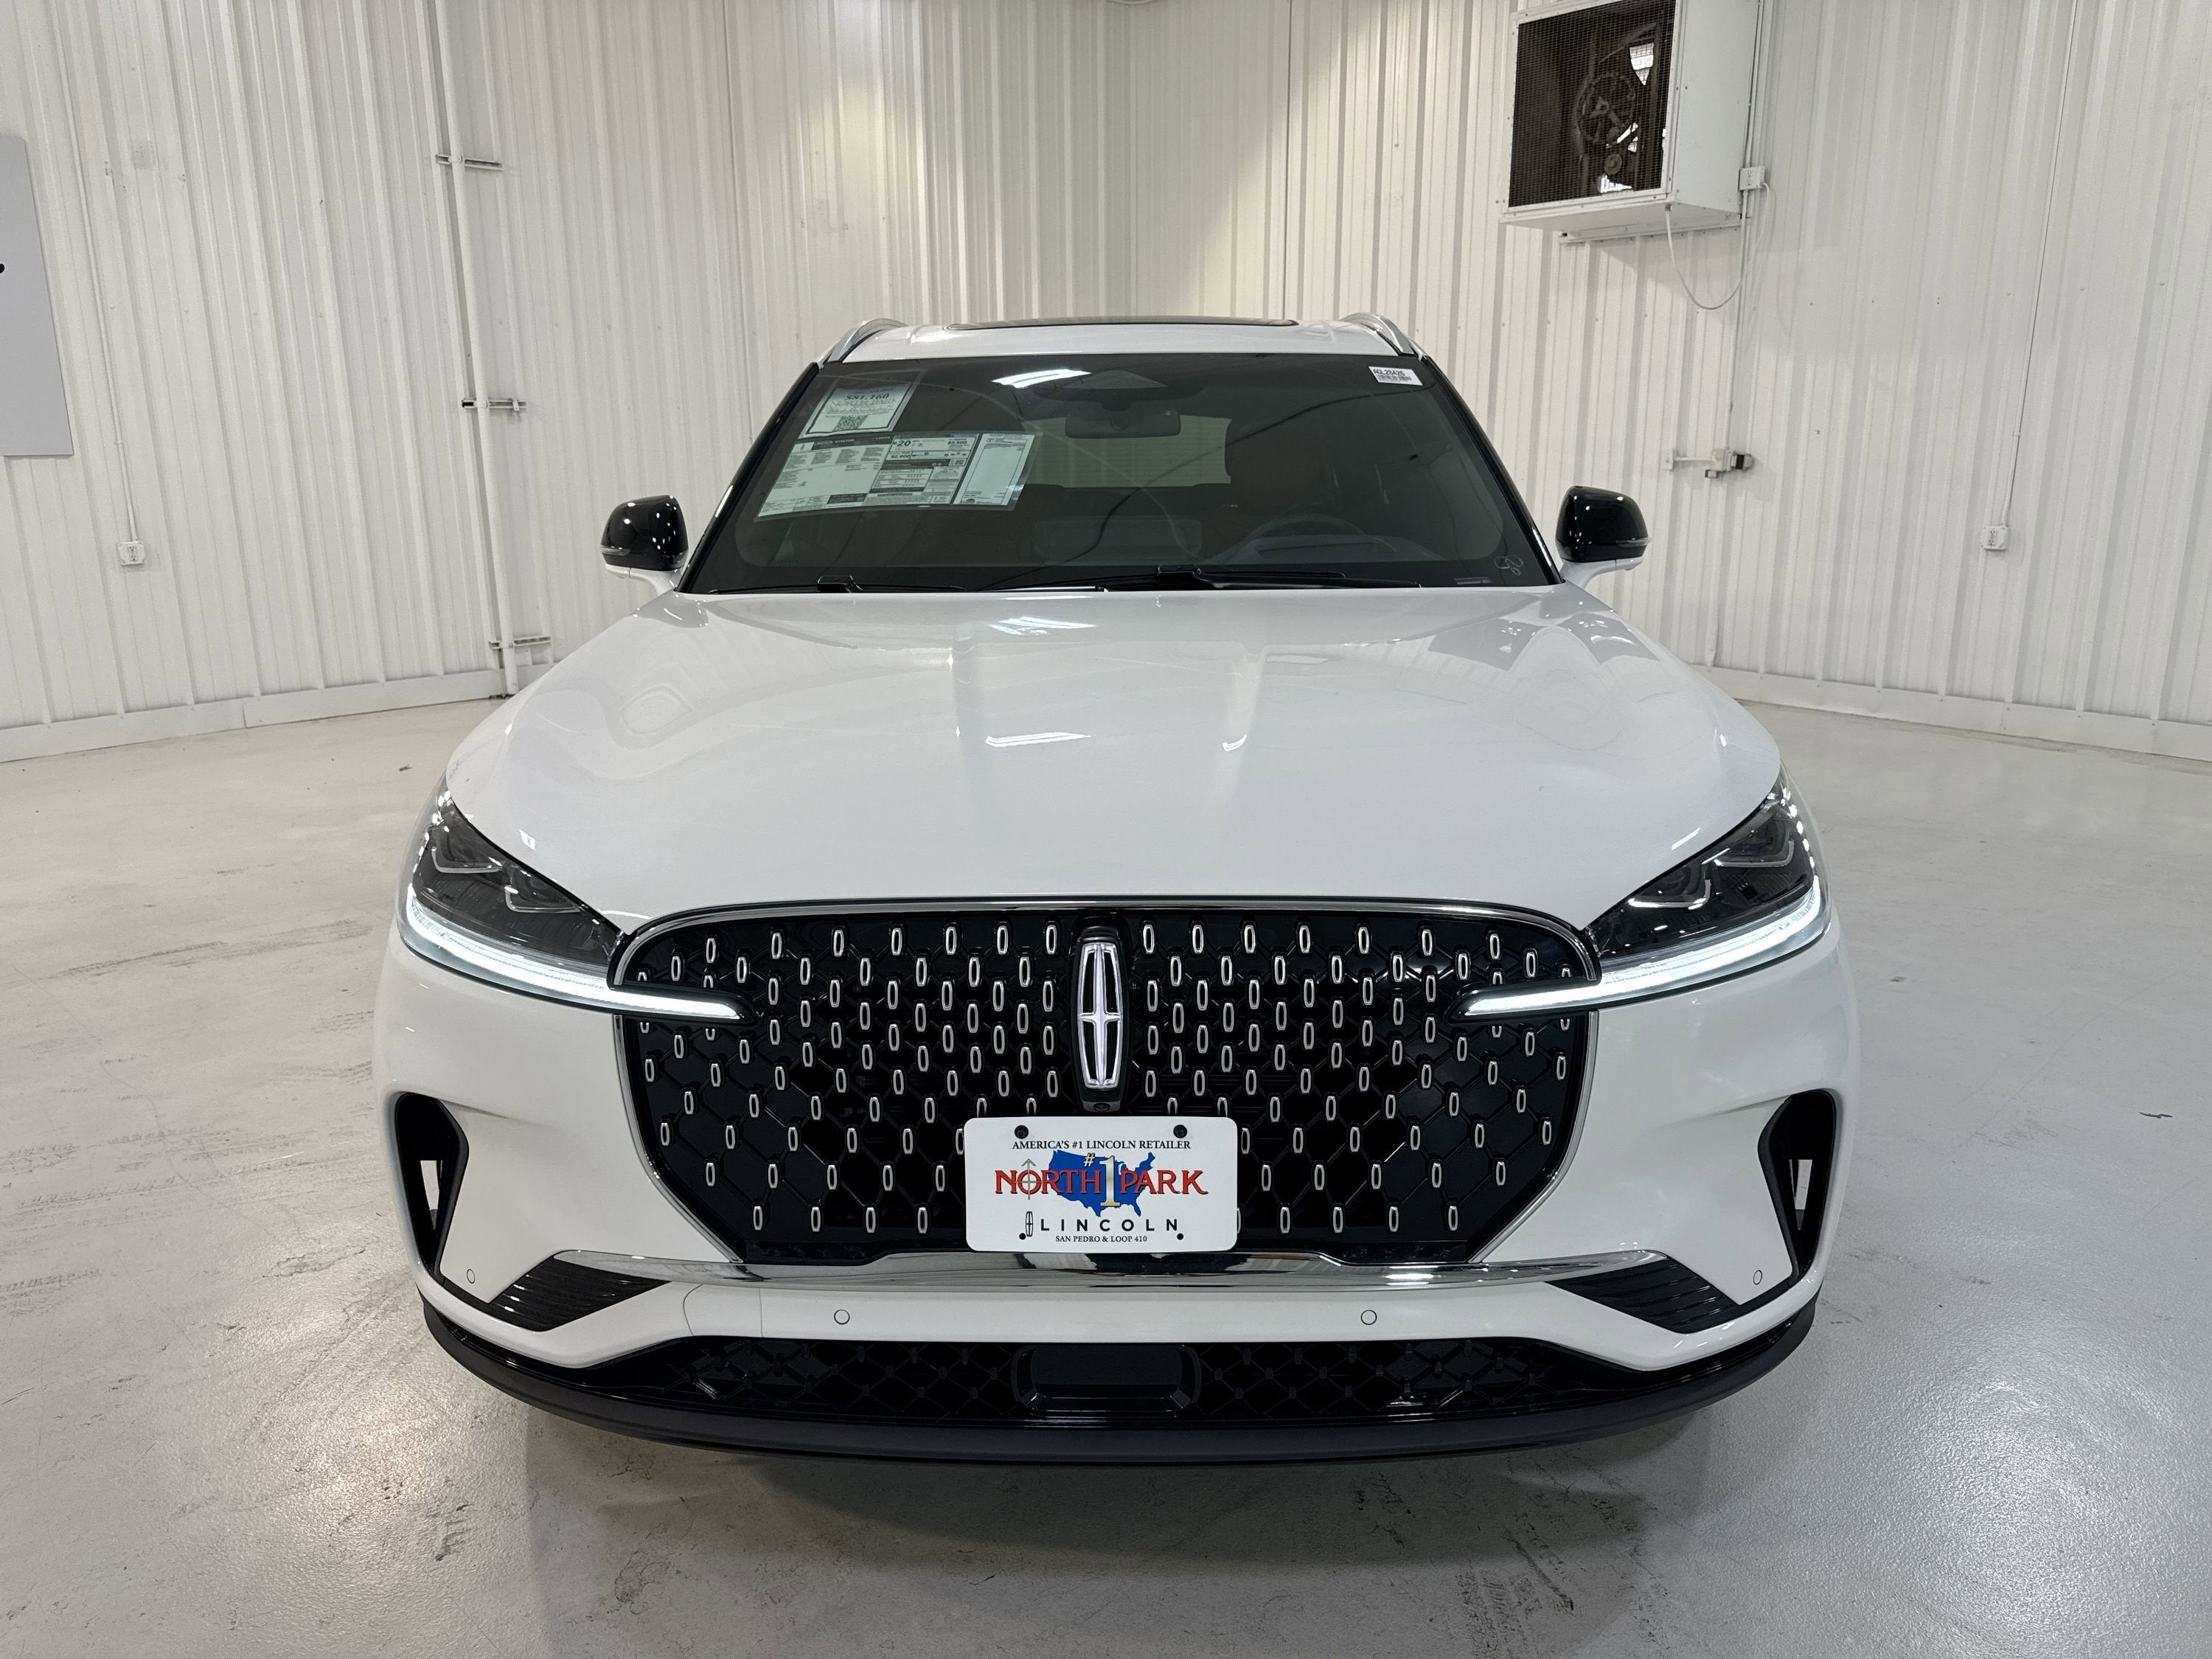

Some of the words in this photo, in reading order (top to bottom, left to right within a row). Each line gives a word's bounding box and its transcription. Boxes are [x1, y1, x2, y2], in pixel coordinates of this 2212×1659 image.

[1012, 1141, 1069, 1150] AMERICA'S
[1072, 1141, 1083, 1150] #1
[1086, 1141, 1136, 1150] LINCOLN
[1139, 1141, 1192, 1150] RETAILER
[995, 1169, 1102, 1195] NORTH
[1120, 1169, 1208, 1195] PARK
[1040, 1218, 1178, 1232] LINCOLN
[1055, 1235, 1071, 1243] SAN
[1073, 1235, 1101, 1243] PEDRO
[1102, 1235, 1109, 1243] &
[1110, 1235, 1133, 1243] LOOP
[1134, 1235, 1148, 1243] 410
